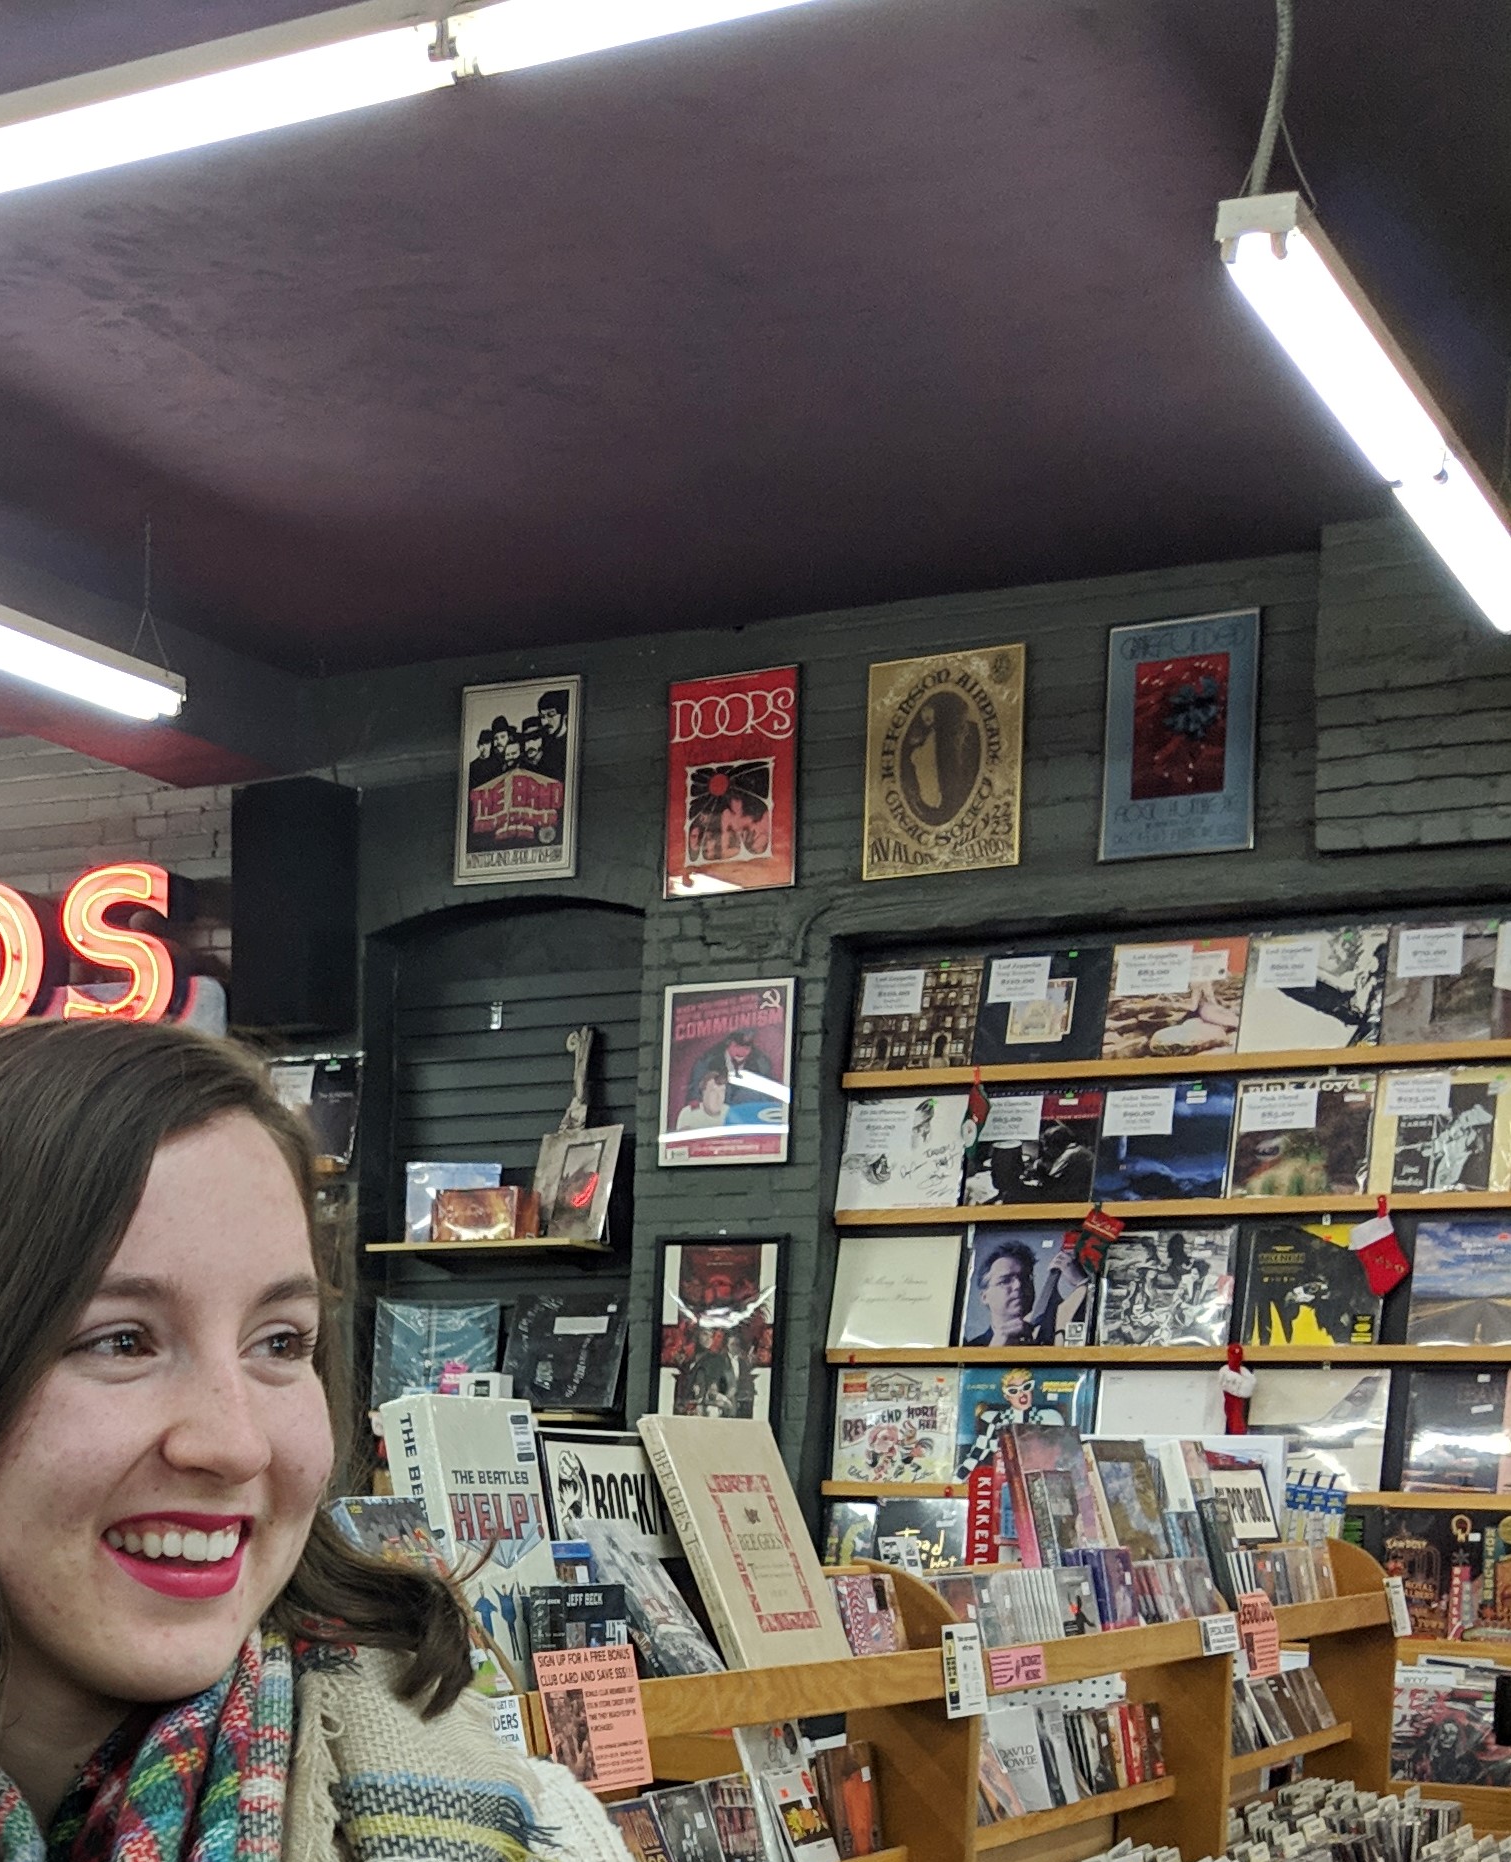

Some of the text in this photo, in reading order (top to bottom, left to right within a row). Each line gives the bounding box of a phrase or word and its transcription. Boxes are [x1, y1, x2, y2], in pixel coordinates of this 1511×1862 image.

[671, 687, 795, 744] DOORS
[674, 1006, 784, 1041] COMMUNISM
[451, 1469, 529, 1486] THE BEATLES
[448, 1493, 545, 1541] HELP!
[565, 1592, 604, 1608] JEFF BECK
[537, 1648, 631, 1668] SIGN UP FOR A FREE BONUS
[540, 1673, 558, 1687] CLUB
[559, 1672, 579, 1685] CARD
[580, 1670, 596, 1683] AND
[596, 1669, 614, 1681] SAVE
